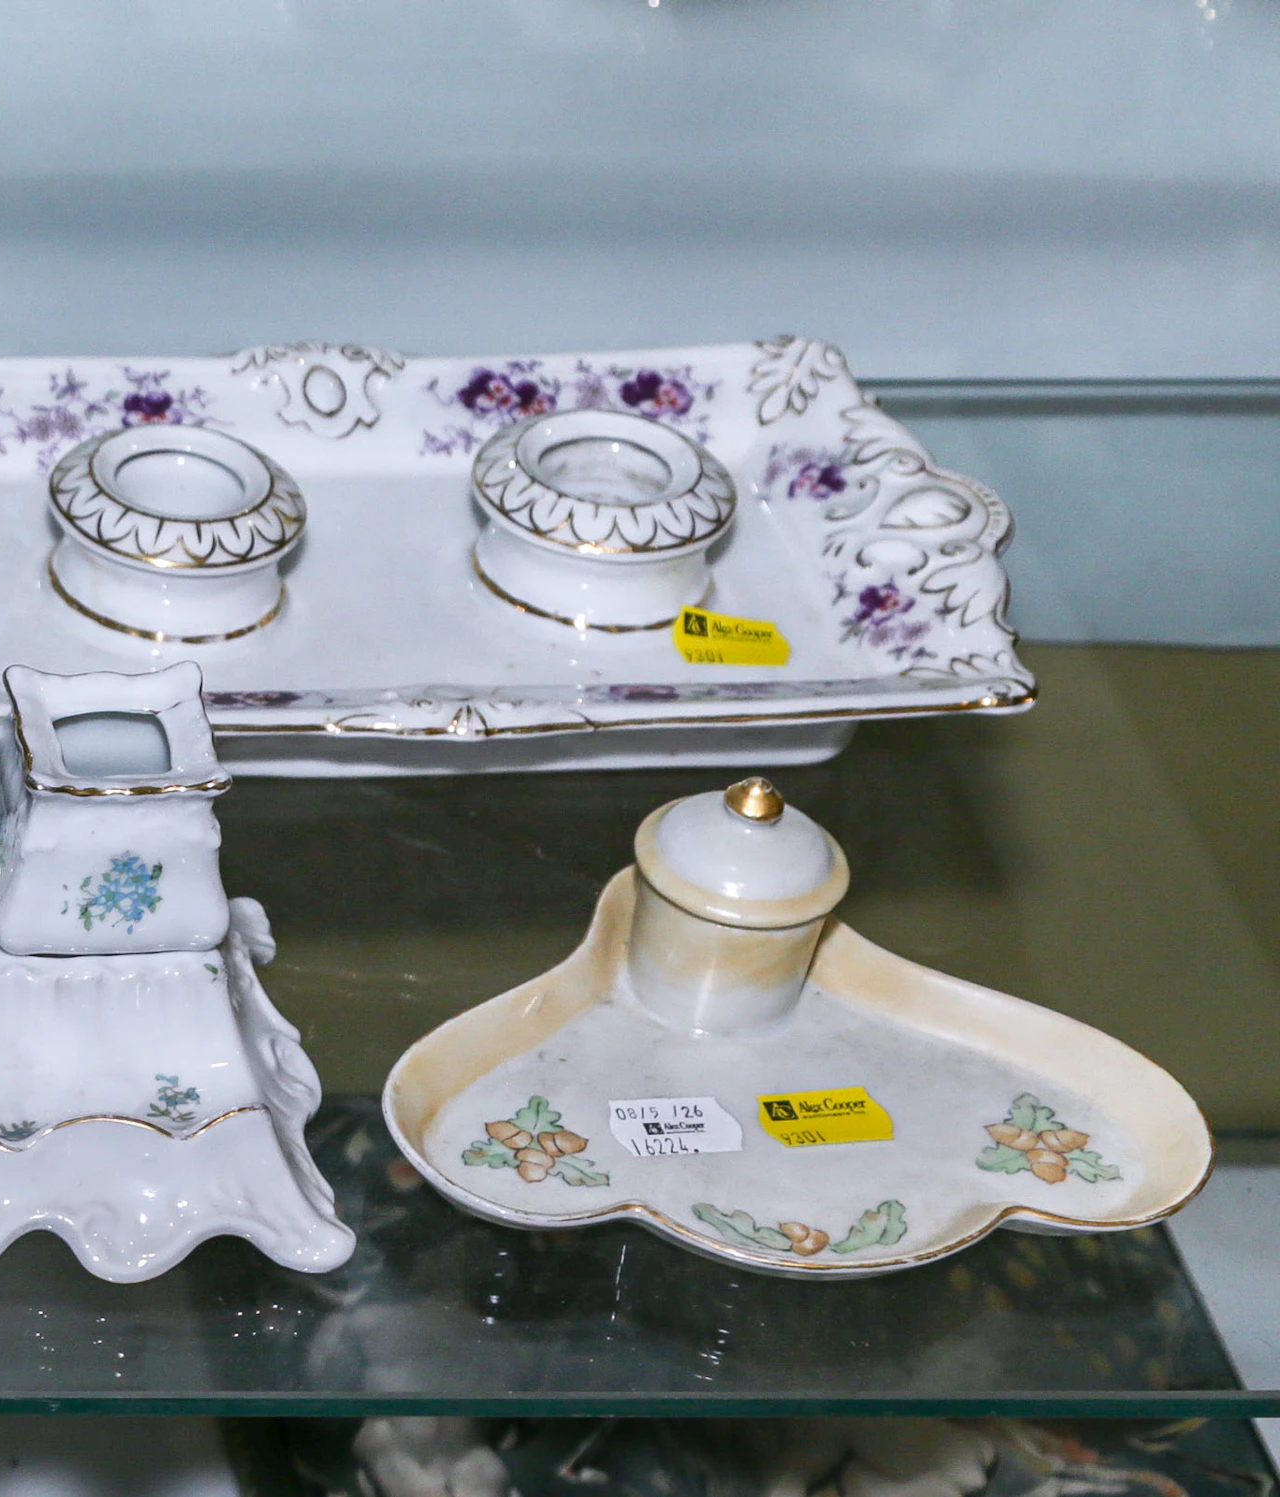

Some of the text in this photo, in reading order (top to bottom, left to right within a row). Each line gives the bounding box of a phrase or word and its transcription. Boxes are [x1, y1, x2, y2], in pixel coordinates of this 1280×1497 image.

[798, 1101, 821, 1114] Alex
[823, 1098, 866, 1111] Cooper
[780, 1130, 826, 1145] 9301
